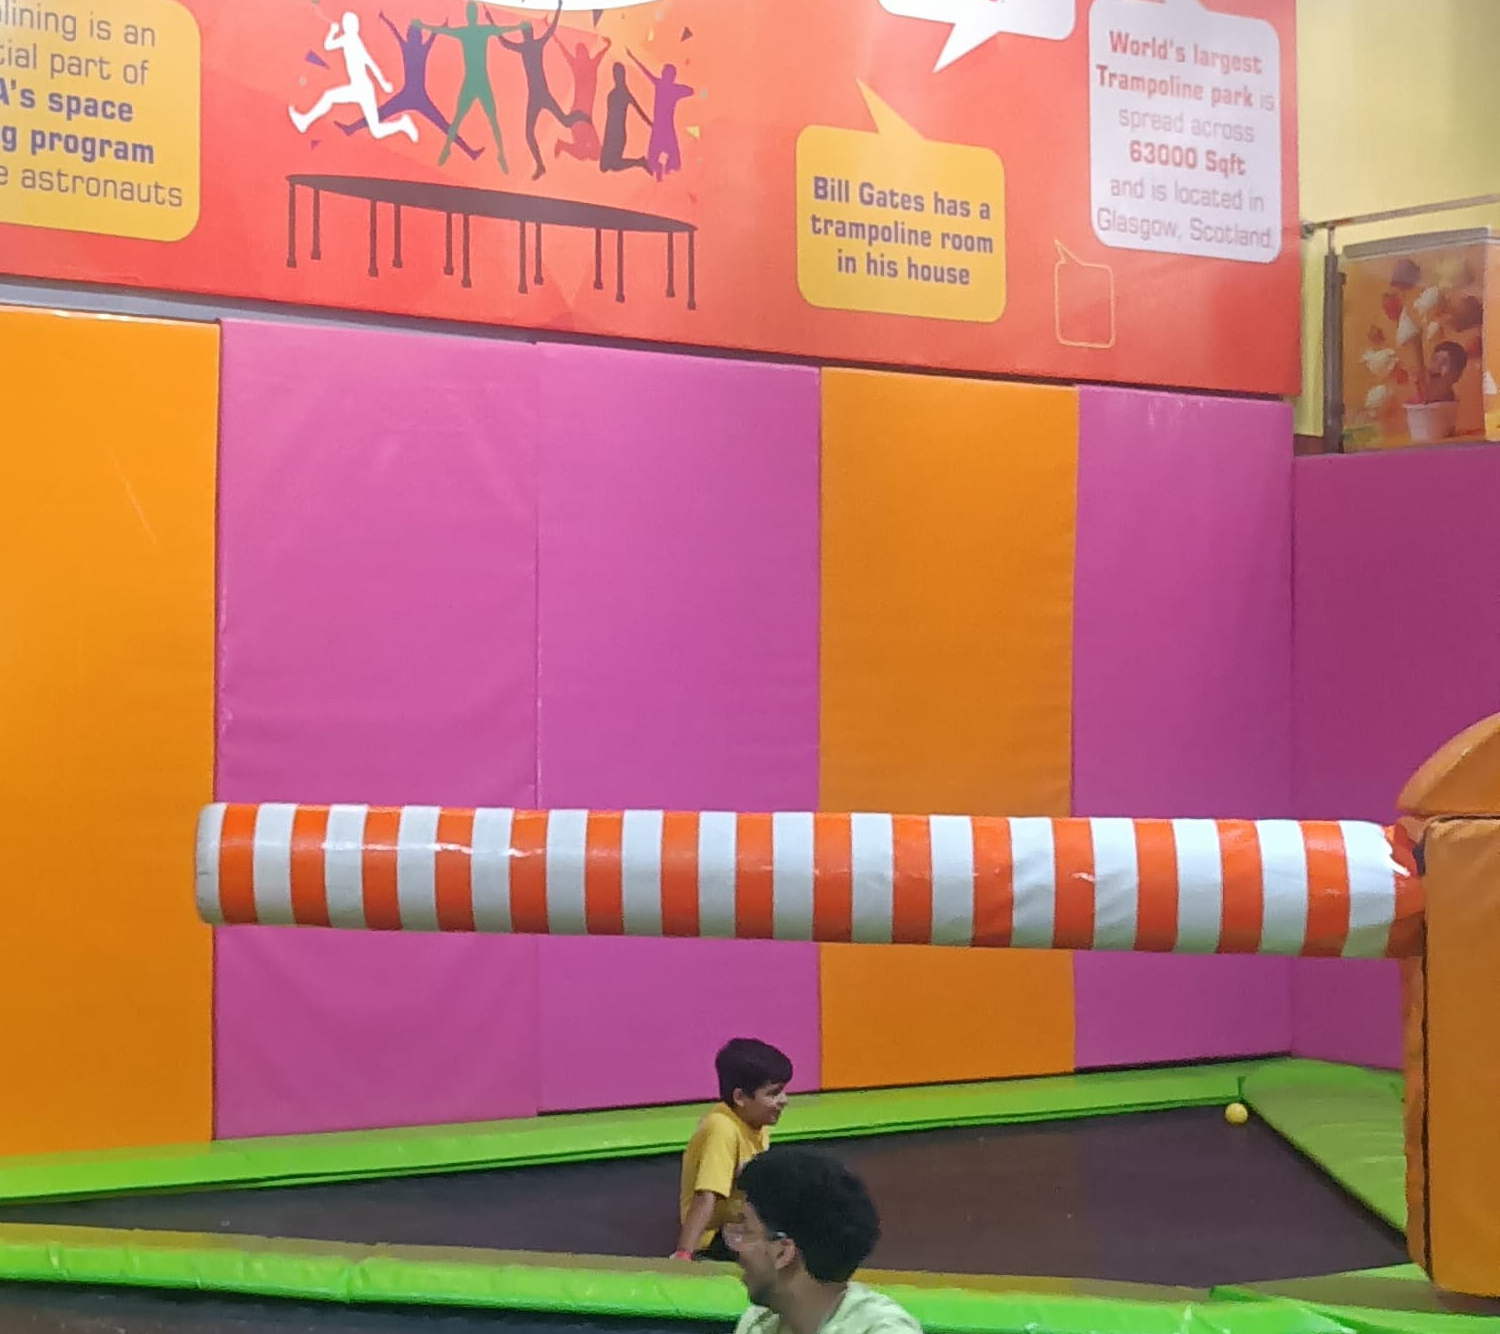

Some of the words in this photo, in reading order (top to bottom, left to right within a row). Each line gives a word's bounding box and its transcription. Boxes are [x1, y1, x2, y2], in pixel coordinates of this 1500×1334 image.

[89, 11, 112, 40] is
[124, 22, 156, 46] an
[50, 52, 111, 81] part
[123, 59, 149, 85] of
[1109, 31, 1186, 63] World's
[1194, 43, 1262, 75] largest
[1096, 64, 1204, 101] Trampoline
[1211, 84, 1253, 107] park
[1260, 93, 1274, 111] is
[48, 92, 133, 122] space
[1118, 107, 1184, 133] spread
[1192, 117, 1255, 143] across
[31, 129, 154, 164] program
[1130, 139, 1197, 169] 63000
[1205, 149, 1246, 177] Sqft
[21, 166, 183, 207] astronauts
[813, 176, 849, 203] Bill
[859, 182, 924, 212] Gates
[934, 191, 970, 217] has
[979, 203, 991, 220] a
[1110, 177, 1144, 199] and
[1152, 182, 1167, 201] is
[1174, 182, 1242, 211] located
[1250, 194, 1264, 211] in
[810, 214, 932, 247] trampoline
[941, 232, 993, 253] room
[1096, 207, 1182, 241] Glasgow,
[837, 249, 856, 274] in
[866, 252, 898, 278] his
[908, 257, 970, 285] house
